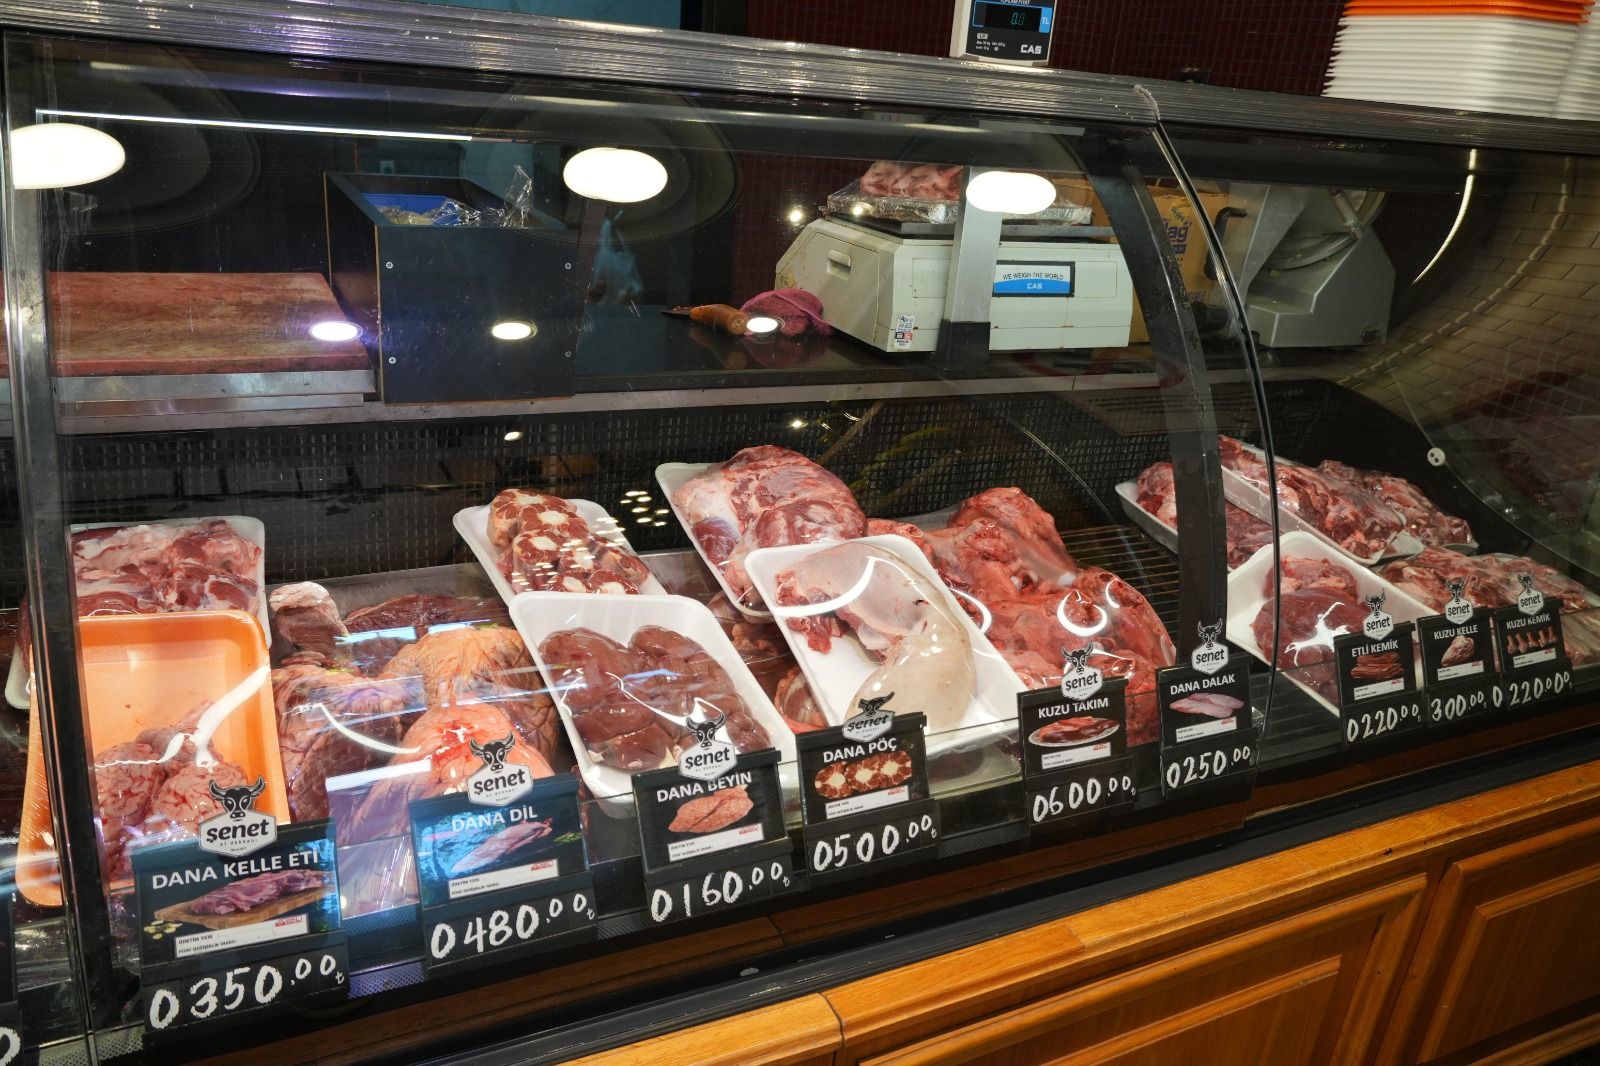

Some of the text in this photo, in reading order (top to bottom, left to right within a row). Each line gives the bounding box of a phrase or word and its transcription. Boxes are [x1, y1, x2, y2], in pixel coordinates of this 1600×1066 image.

[1020, 44, 1042, 54] CAS
[1433, 624, 1478, 640] KUZU KELLE
[1506, 613, 1550, 630] KUZU KEMİK
[1351, 640, 1399, 657] ETLİ KEMİK
[1170, 674, 1235, 695] DANA DALAK
[1038, 697, 1109, 719] KUZU TAKIM
[823, 738, 897, 763] DANA PÖÇ
[656, 771, 752, 803] DANA BEYİN
[452, 805, 538, 832] DANA DİL
[152, 850, 318, 890] DANA KELLE ETİ
